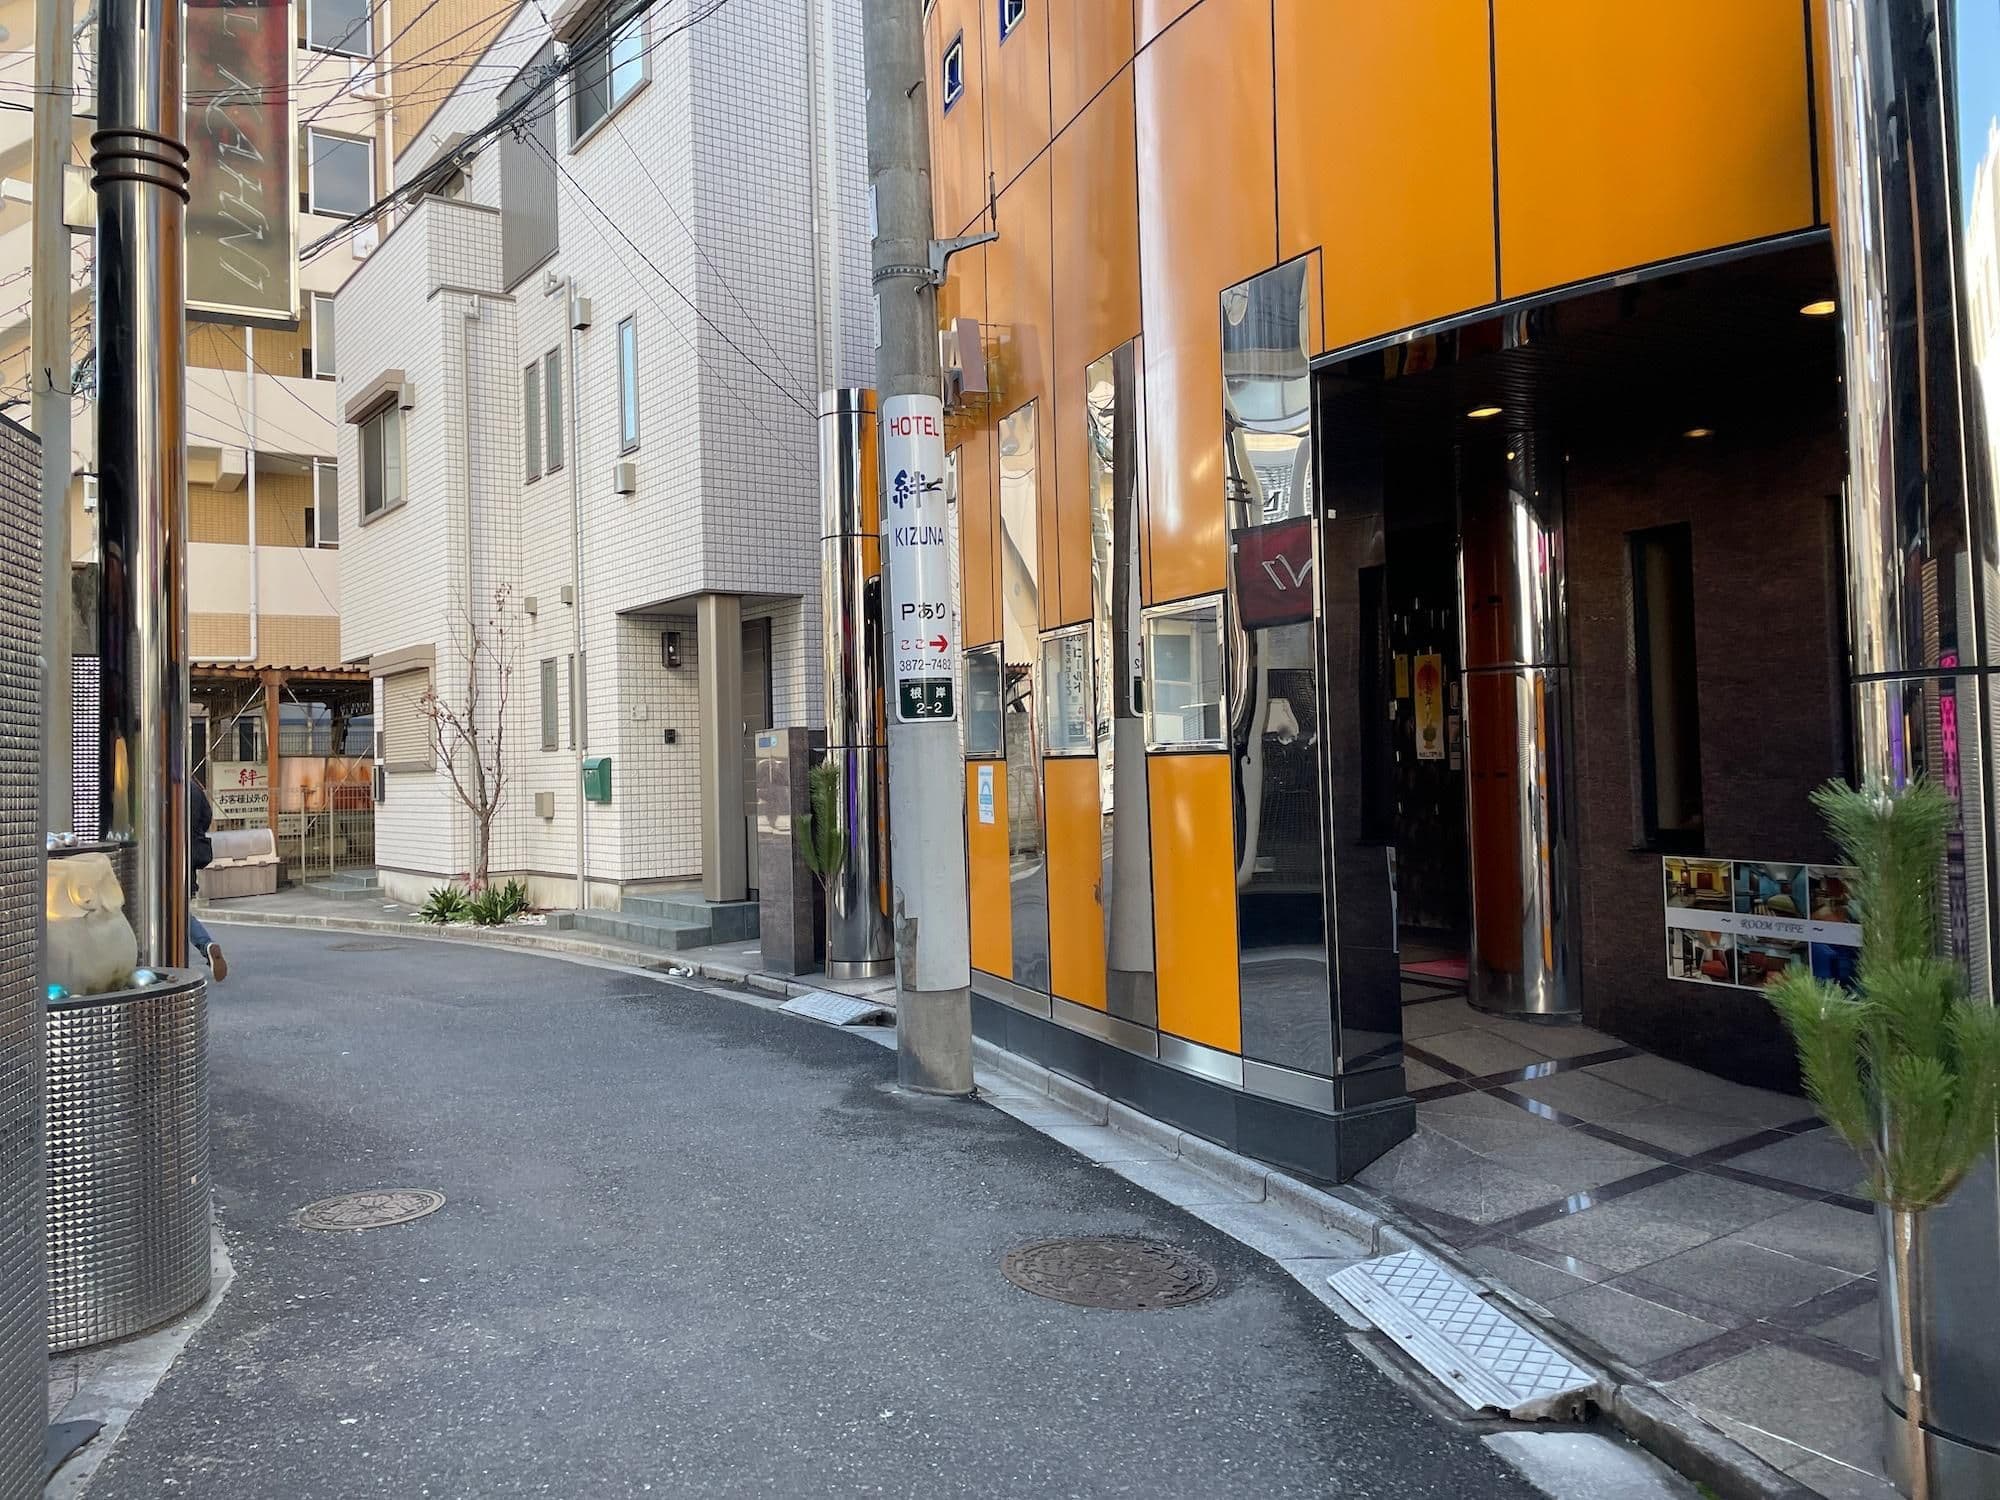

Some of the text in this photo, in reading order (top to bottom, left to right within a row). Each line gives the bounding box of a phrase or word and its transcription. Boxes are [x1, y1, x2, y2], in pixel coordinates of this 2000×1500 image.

[890, 416, 940, 437] HOTEL
[894, 526, 945, 547] KIZUNA
[900, 639, 926, 651] ここ
[899, 659, 951, 672] 3872-7482
[910, 686, 946, 700] 根岸
[916, 702, 943, 714] 2-2
[1740, 918, 1804, 934] ROOM TYPE
